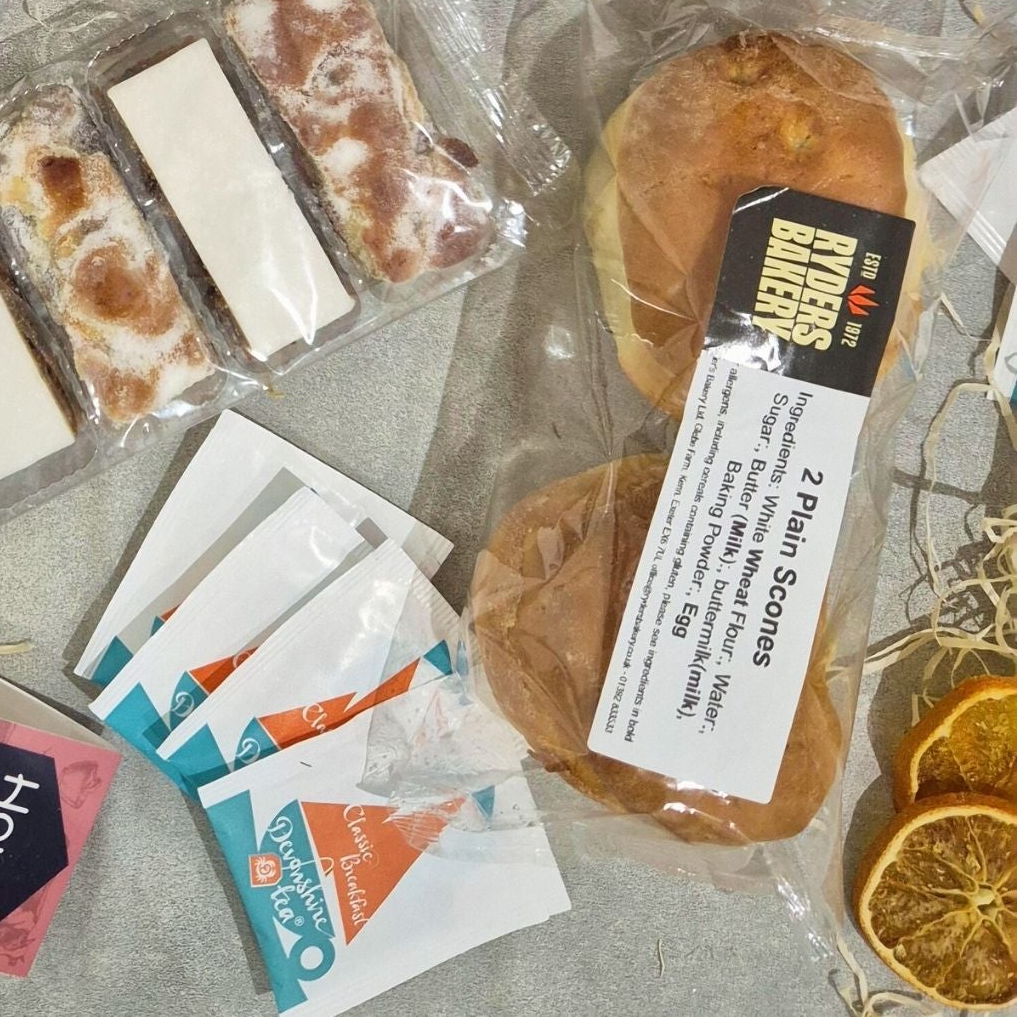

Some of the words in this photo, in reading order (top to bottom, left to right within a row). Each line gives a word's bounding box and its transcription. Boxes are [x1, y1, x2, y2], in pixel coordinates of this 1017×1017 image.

[750, 217, 815, 341] BAKERY
[789, 228, 857, 351] RYDERS
[859, 251, 882, 280] ESTD
[839, 319, 862, 349] 1972
[717, 368, 738, 417] allergens,
[704, 420, 724, 465] including
[768, 392, 813, 488] Ingredients:
[694, 466, 710, 503] cereals
[708, 460, 742, 518] Baking
[739, 459, 767, 511] Butter
[801, 468, 823, 486] 2
[675, 505, 698, 556] containing
[752, 496, 780, 543] White
[779, 491, 818, 558] Plain
[665, 557, 683, 590] gluten,
[734, 549, 764, 607] Wheat
[655, 593, 671, 626] please
[672, 602, 699, 639] Egg
[753, 566, 797, 668] Scones
[650, 628, 660, 647] see
[634, 649, 655, 705] ingredients
[624, 719, 639, 742] bold
[631, 708, 639, 718] in
[341, 804, 378, 863] Classic
[266, 817, 335, 936] Devonshire
[338, 852, 369, 925] Breakfast
